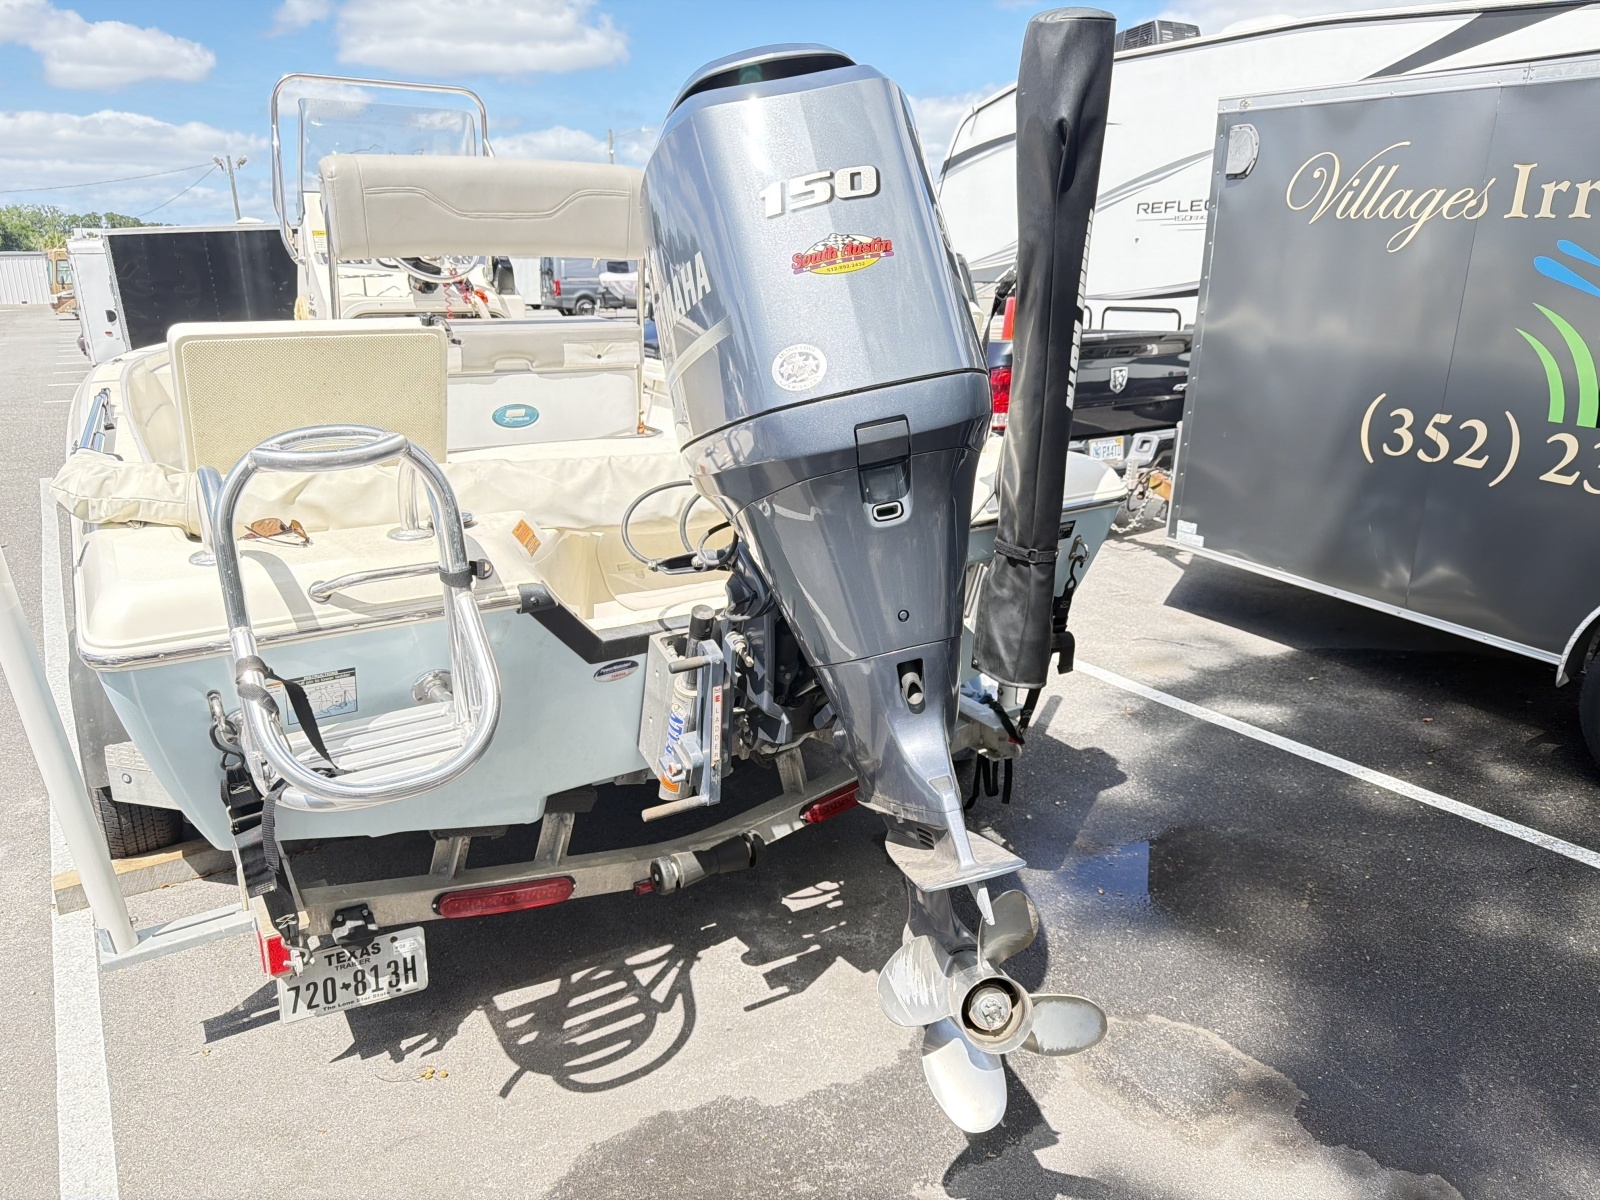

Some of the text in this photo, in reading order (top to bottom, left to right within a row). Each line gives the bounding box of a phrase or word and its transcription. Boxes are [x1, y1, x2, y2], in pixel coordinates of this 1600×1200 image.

[759, 165, 881, 220] 150
[1286, 141, 1496, 253] Villages
[792, 237, 893, 269] South Austin
[803, 253, 887, 271] MARINE
[1361, 393, 1520, 487] (352)
[324, 942, 381, 967] TEXAS
[335, 957, 371, 972] TRAILER
[323, 990, 391, 1012] The Lone Star State
